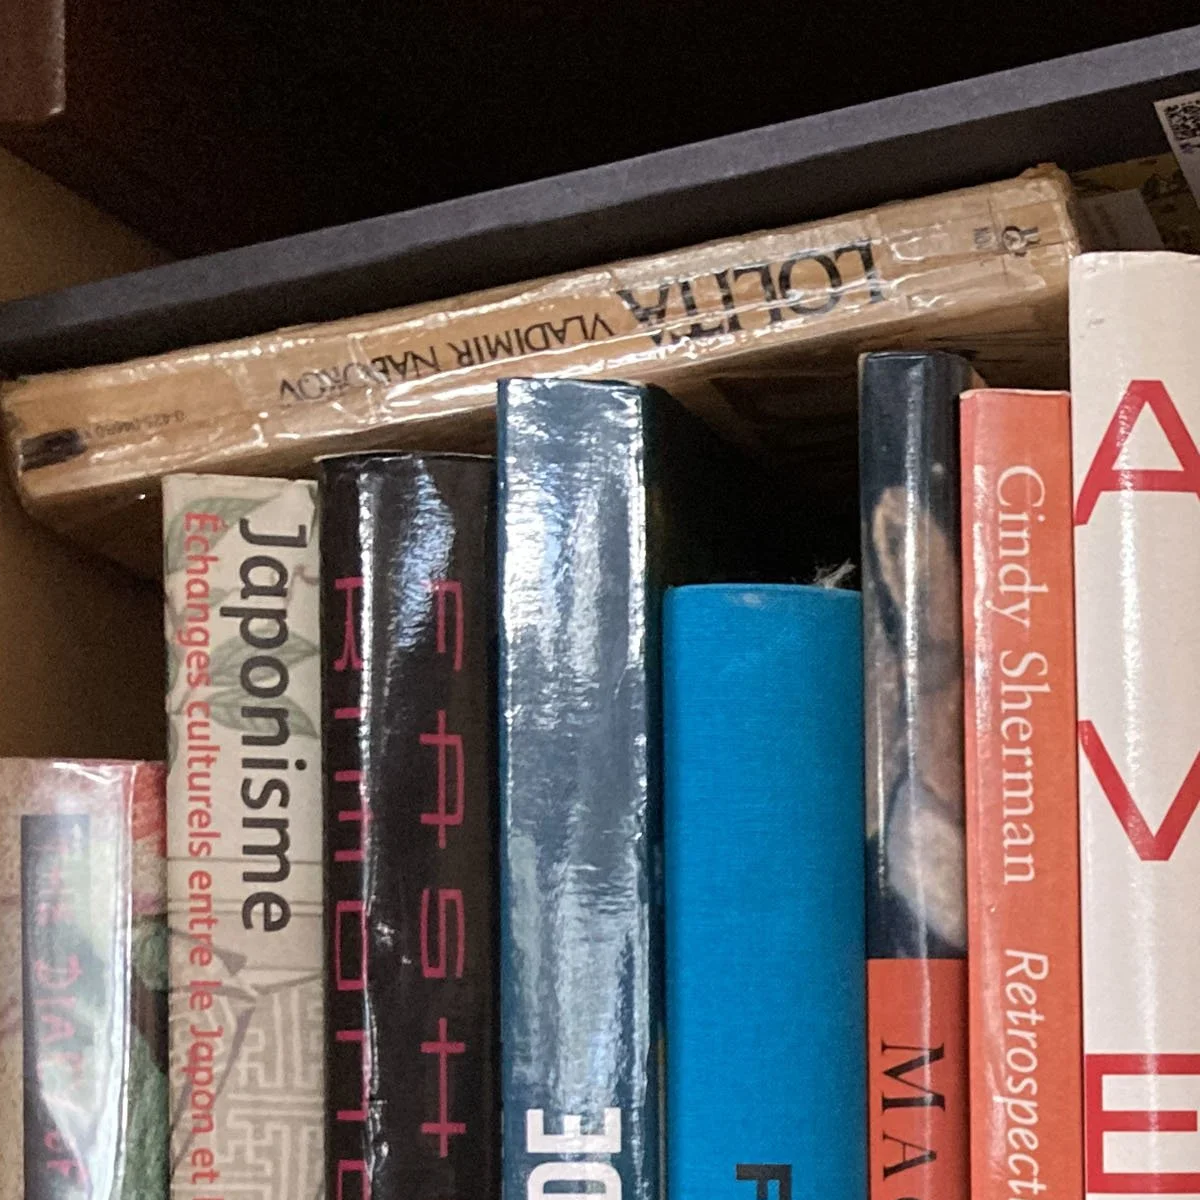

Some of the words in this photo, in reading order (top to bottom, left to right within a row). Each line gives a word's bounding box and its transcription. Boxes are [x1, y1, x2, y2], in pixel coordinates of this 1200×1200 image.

[455, 312, 615, 367] VLADIMIR
[176, 510, 226, 688] Échanges
[984, 465, 1050, 630] Cindy
[184, 701, 222, 858] culturels
[218, 517, 308, 933] Japonisme
[998, 650, 1051, 886] Sherman
[187, 868, 220, 967] entre
[189, 979, 222, 1010] le
[181, 1024, 224, 1135] Japon
[190, 1146, 221, 1185] et
